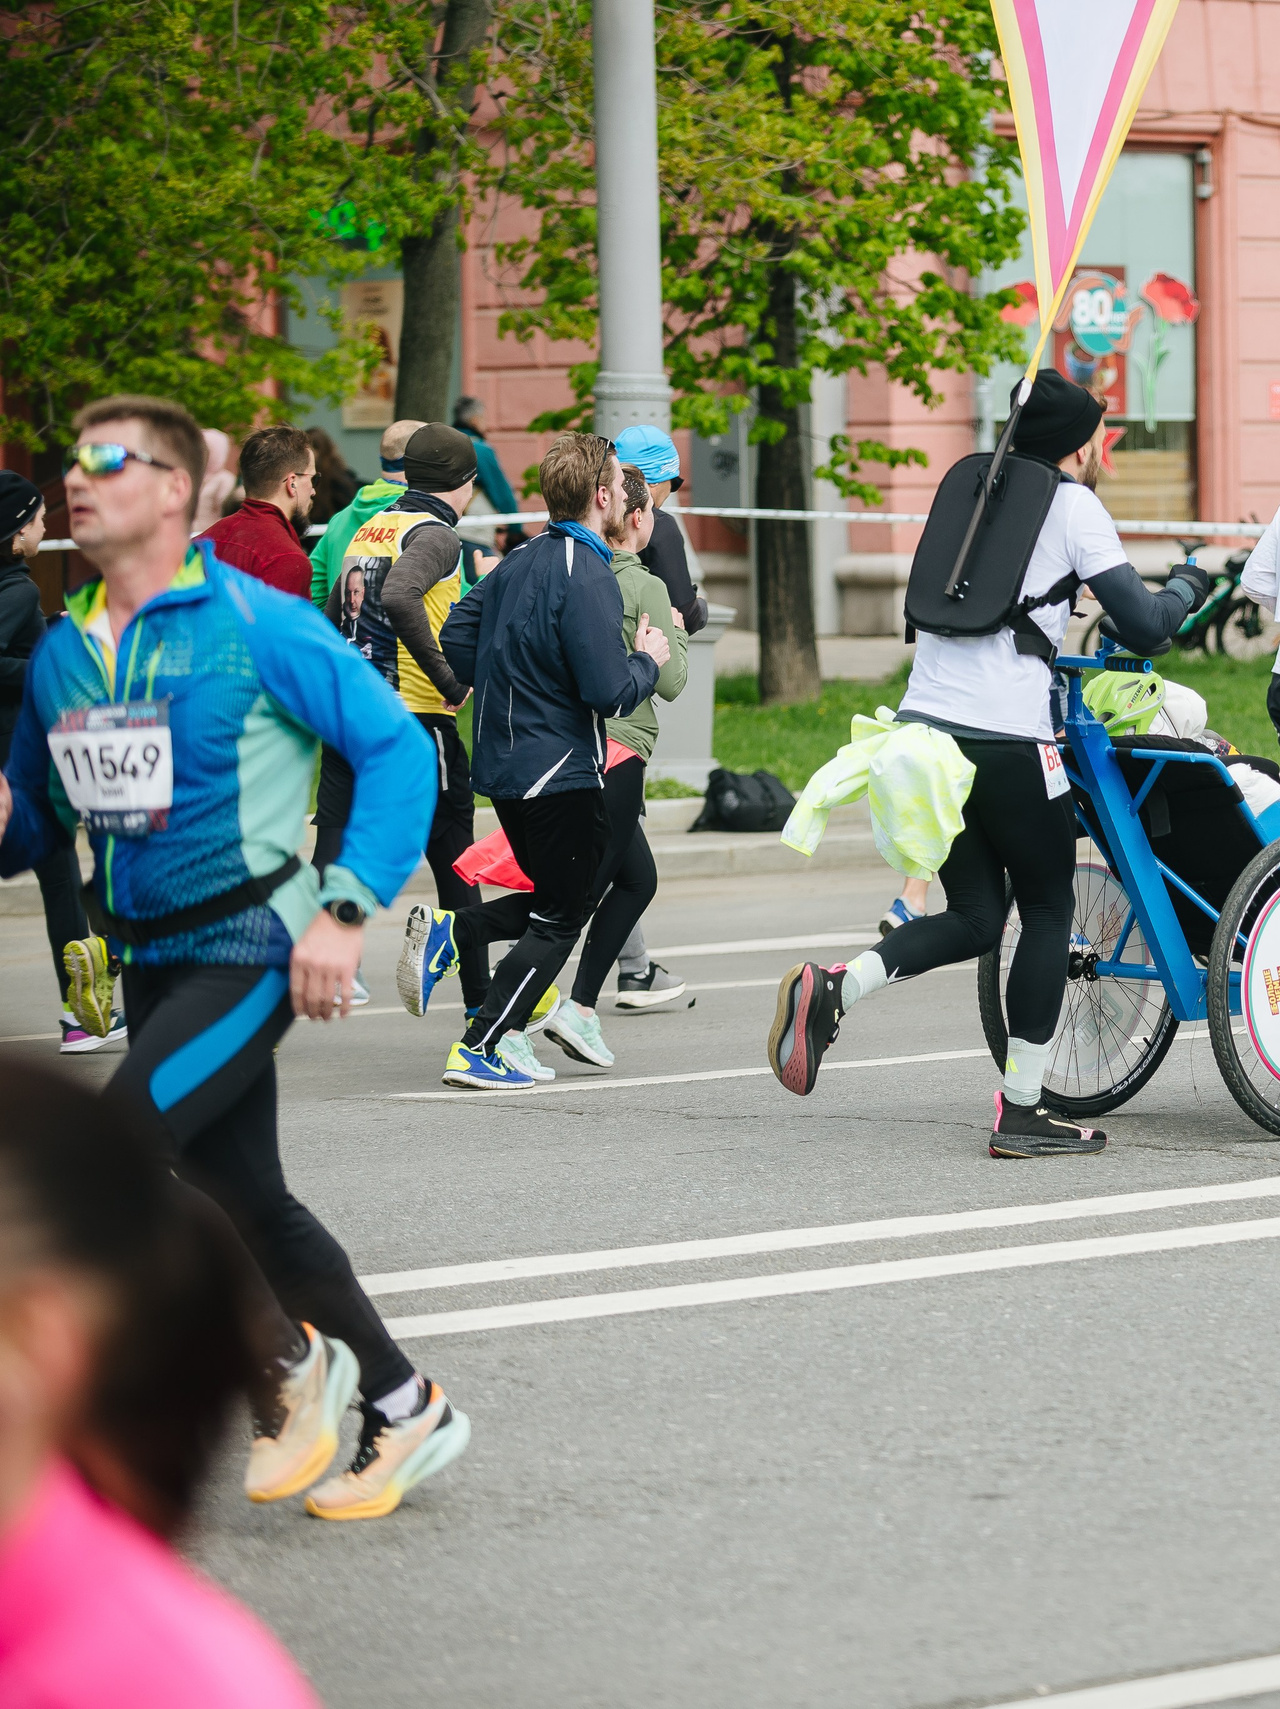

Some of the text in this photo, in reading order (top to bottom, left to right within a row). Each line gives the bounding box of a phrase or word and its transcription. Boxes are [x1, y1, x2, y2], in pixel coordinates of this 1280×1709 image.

[1072, 289, 1113, 326] 80
[63, 744, 160, 784] 11549
[1263, 969, 1279, 1014] БОЛЬШЕ
